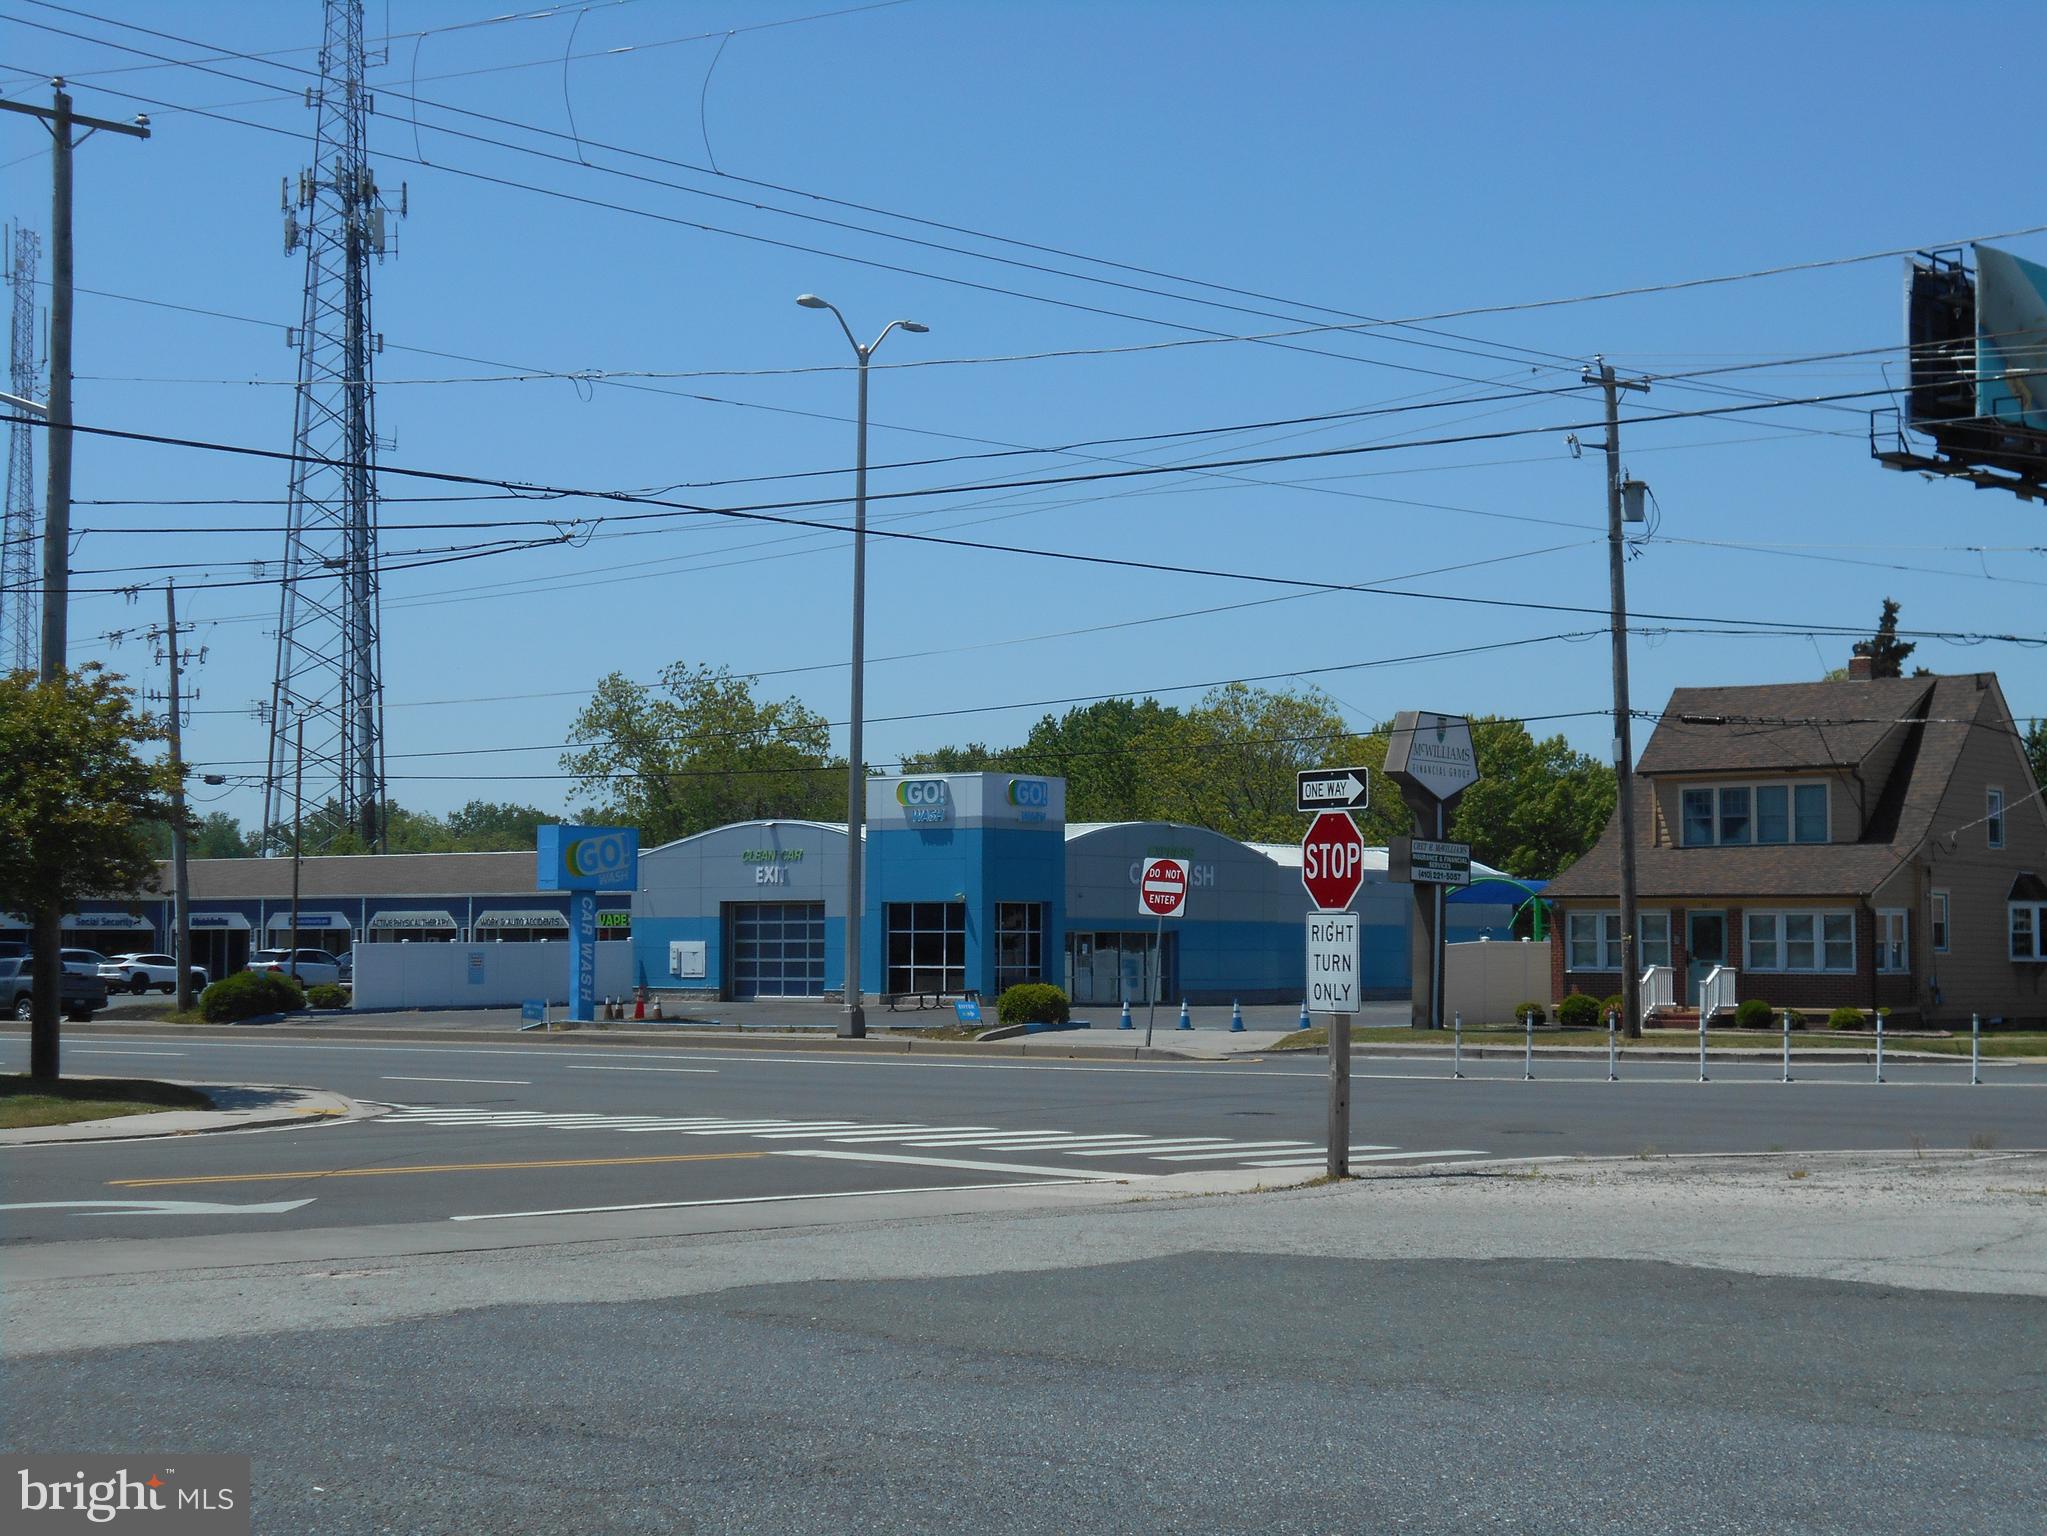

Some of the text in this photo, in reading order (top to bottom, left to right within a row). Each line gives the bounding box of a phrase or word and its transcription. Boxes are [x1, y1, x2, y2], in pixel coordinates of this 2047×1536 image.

[1412, 763, 1471, 779] FINANCIAL GROUP
[907, 782, 945, 804] GO!
[1016, 783, 1048, 805] GO!
[1305, 781, 1347, 797] ONE WAY
[912, 808, 945, 823] WASH
[577, 832, 631, 873] GO!
[742, 848, 804, 863] CLEAN CAR
[1306, 842, 1360, 880] STOP
[600, 870, 629, 885] WASH
[756, 866, 787, 883] EXIT
[1149, 868, 1161, 878] DO
[1165, 869, 1181, 880] NOT
[1149, 894, 1176, 905] ENTER
[75, 917, 133, 928] Social Security
[599, 914, 627, 926] VAPE
[1312, 924, 1354, 942] RIGHT
[580, 896, 593, 1002] CAR WASH
[1314, 953, 1351, 972] TURN
[1314, 983, 1352, 1002] ONLY
